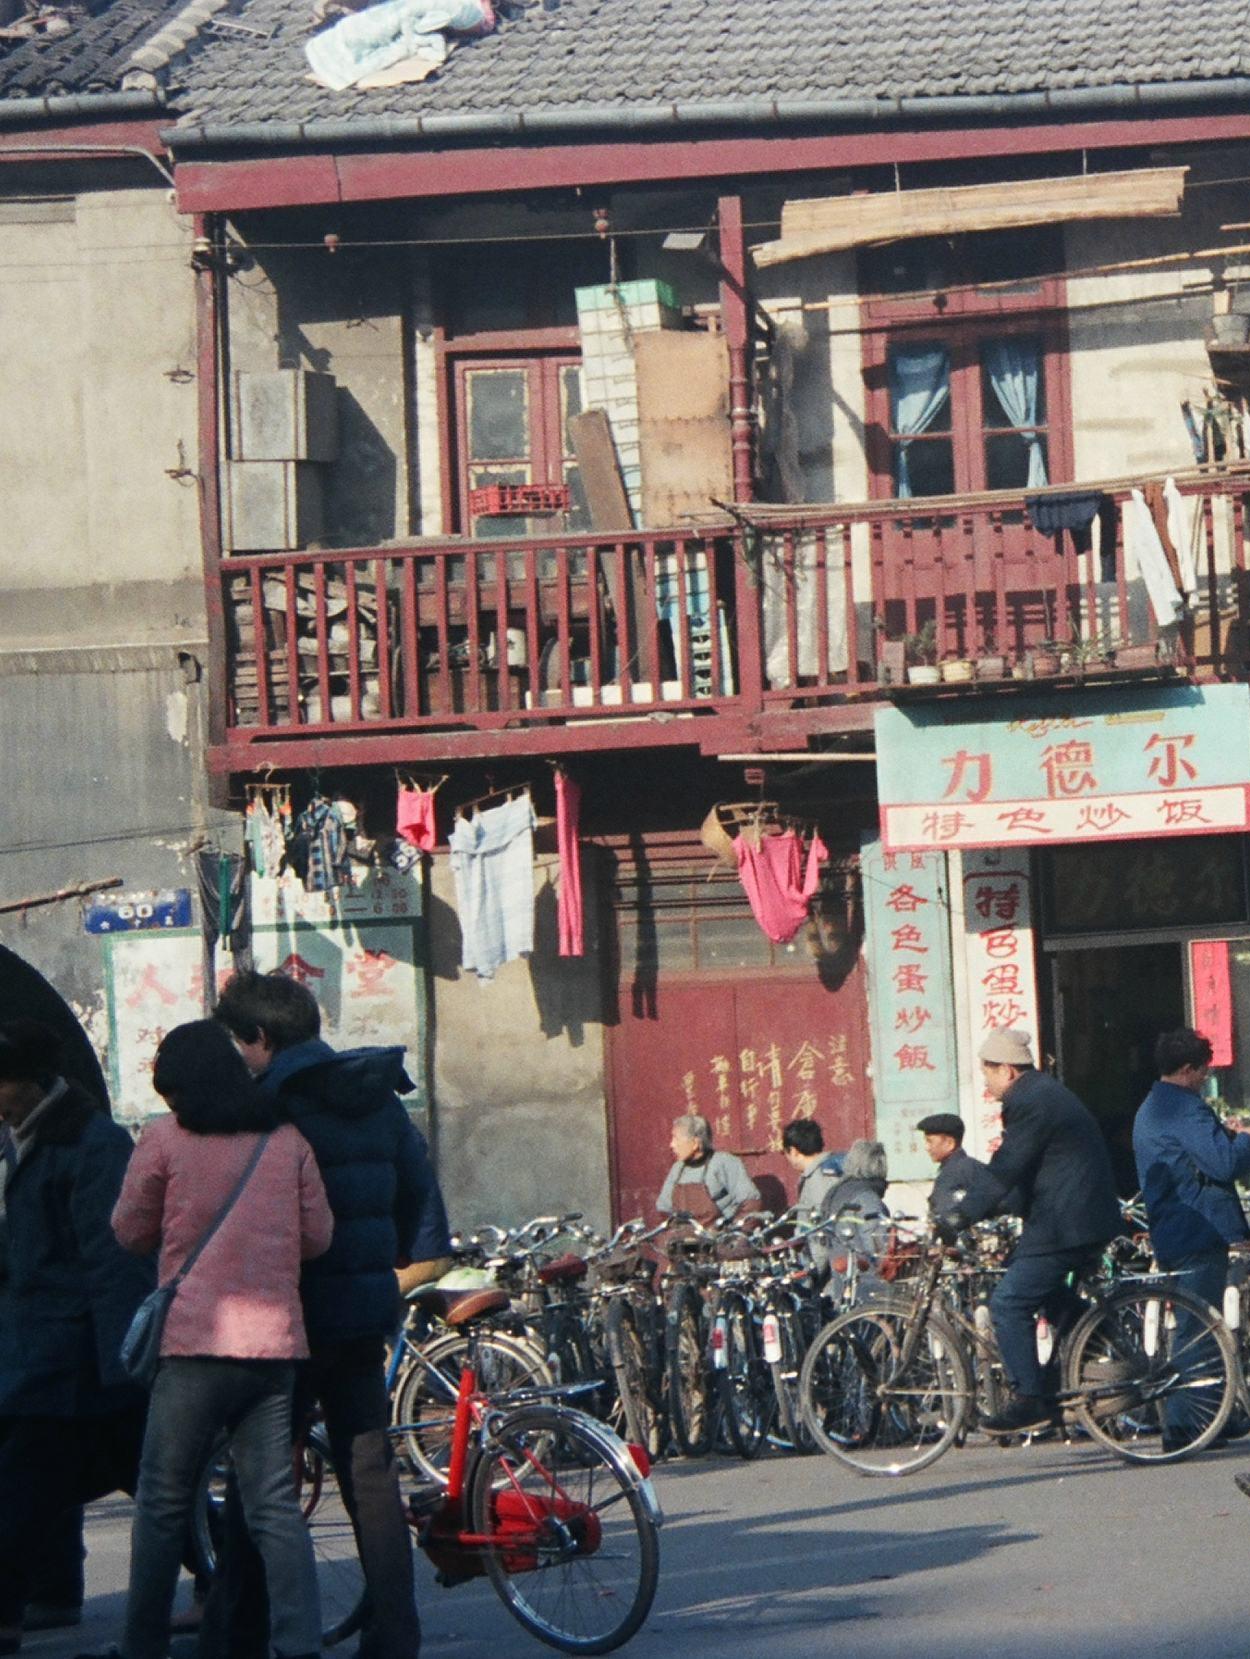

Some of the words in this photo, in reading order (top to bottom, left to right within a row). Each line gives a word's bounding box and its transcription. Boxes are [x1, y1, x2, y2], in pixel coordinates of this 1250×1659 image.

[939, 732, 1198, 801] 力德尔
[921, 799, 1212, 841] 特色炒饭
[885, 883, 936, 1071] 各色蛋炒飯
